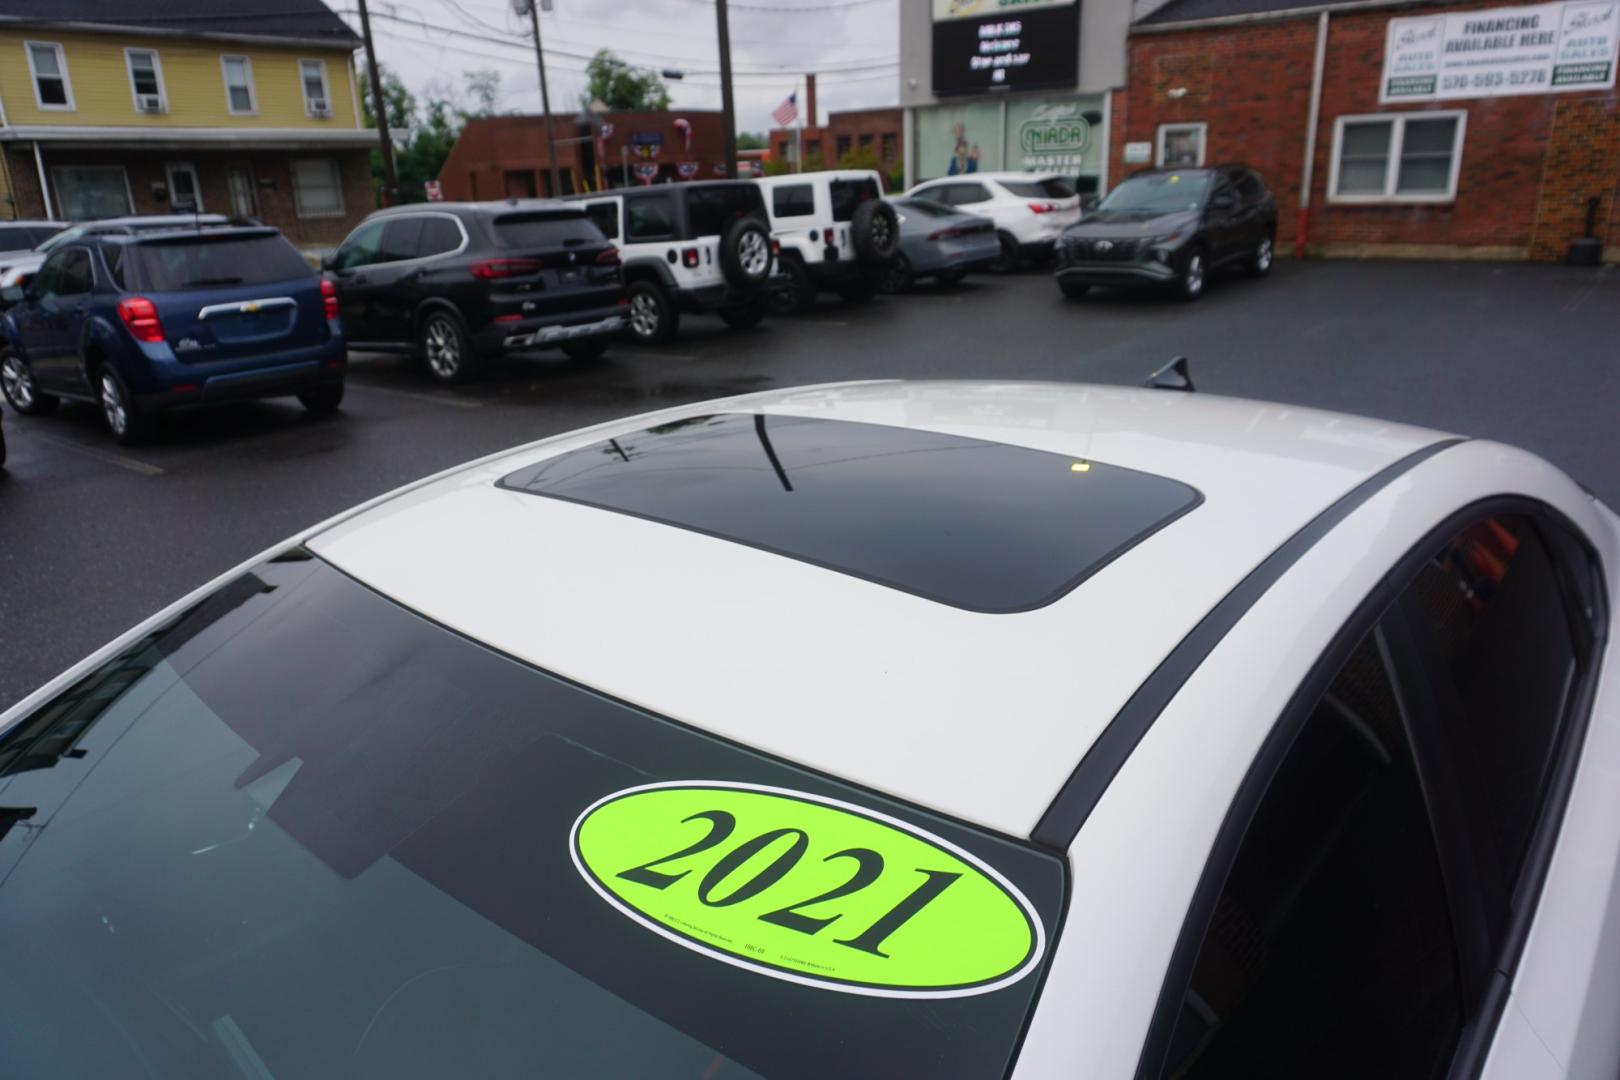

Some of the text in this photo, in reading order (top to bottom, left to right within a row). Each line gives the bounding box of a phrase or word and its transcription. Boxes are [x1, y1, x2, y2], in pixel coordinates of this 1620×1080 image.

[1463, 15, 1540, 35] FINANCING
[1445, 33, 1516, 53] AVAILABLE
[1519, 30, 1555, 47] HERE
[614, 809, 963, 959] 2021
